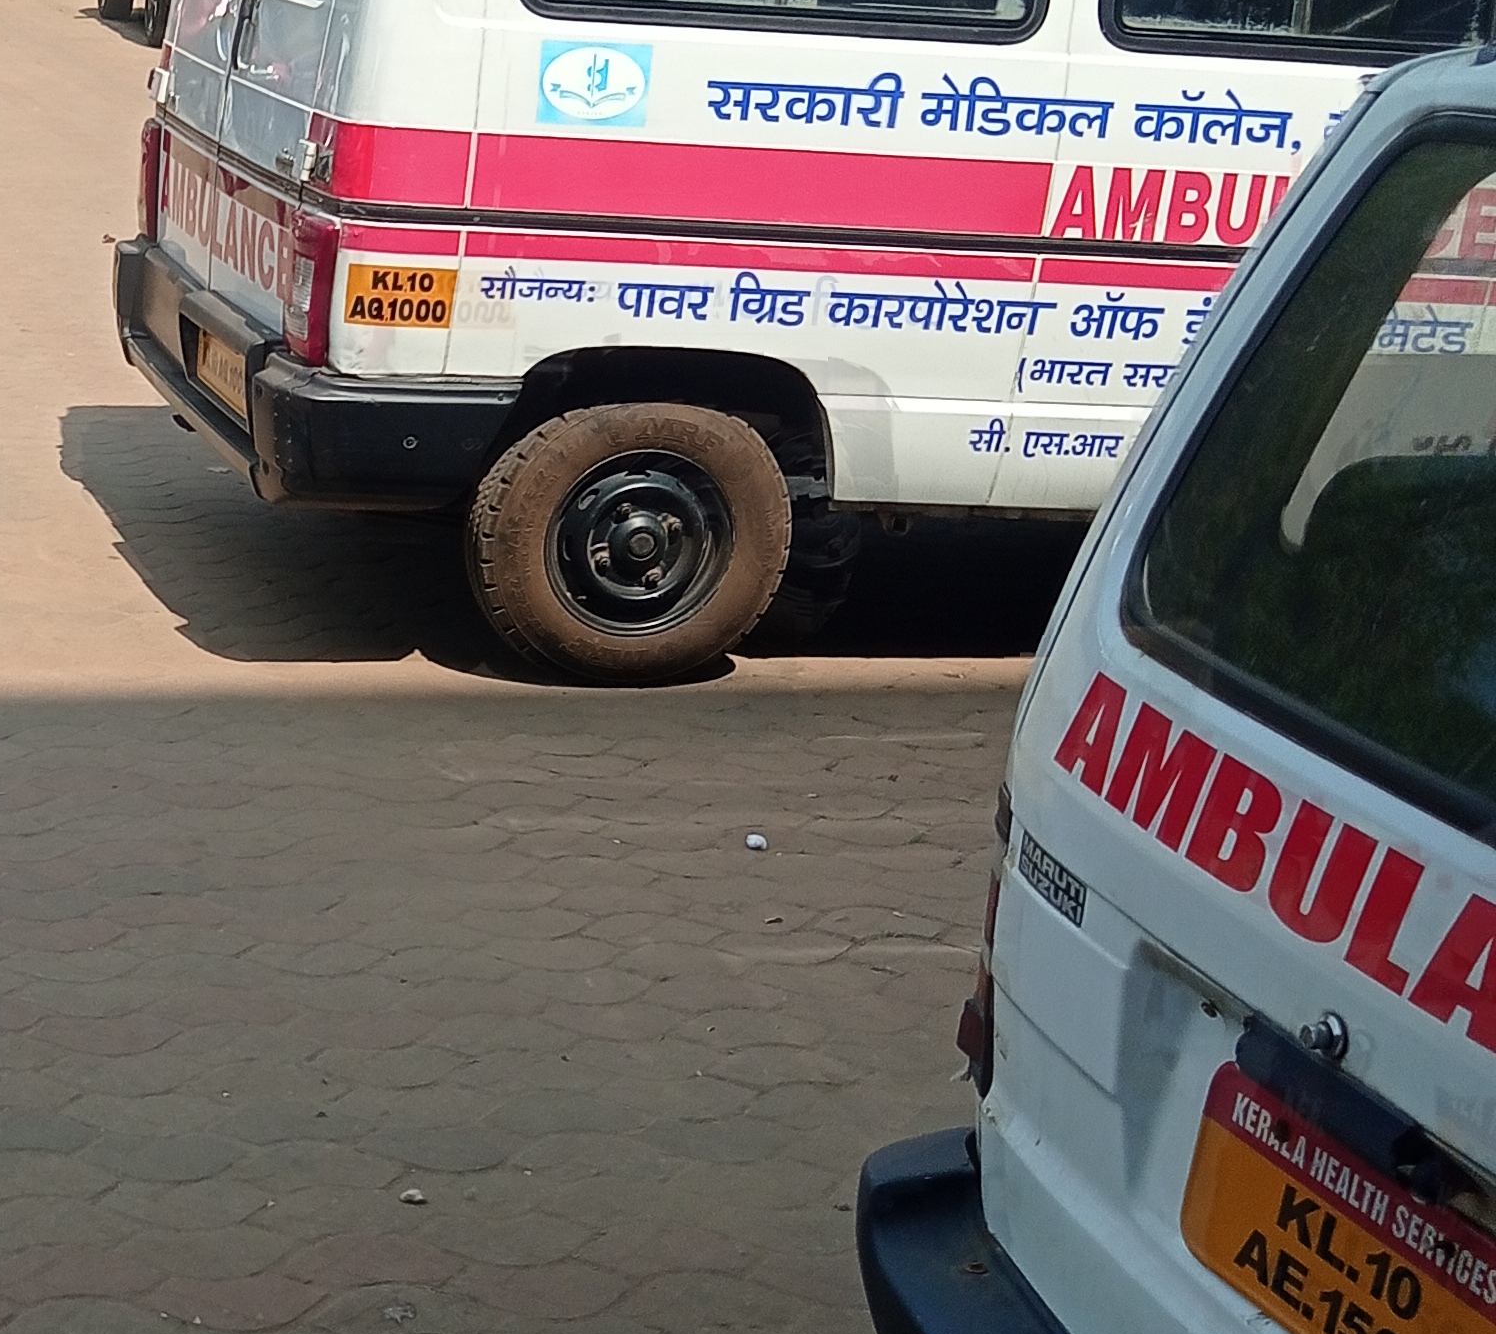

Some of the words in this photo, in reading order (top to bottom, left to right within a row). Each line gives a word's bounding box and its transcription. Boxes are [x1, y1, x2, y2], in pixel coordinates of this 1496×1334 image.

[706, 72, 906, 129] सरकारी
[919, 73, 1115, 140] मेडिकल
[1133, 88, 1302, 156] कॉलेज,
[617, 281, 715, 321] पावर
[729, 271, 812, 328] ग्रिड
[828, 279, 1057, 336] कारपोरेशन
[1070, 291, 1165, 341] ऑफ
[1015, 356, 1114, 393] (भारत
[1123, 363, 1181, 388] सर
[1020, 853, 1082, 924] SUZUKI
[1024, 834, 1085, 905] MARUTI
[1309, 1146, 1391, 1226] HEALTH
[1276, 1183, 1422, 1321] KL.10
